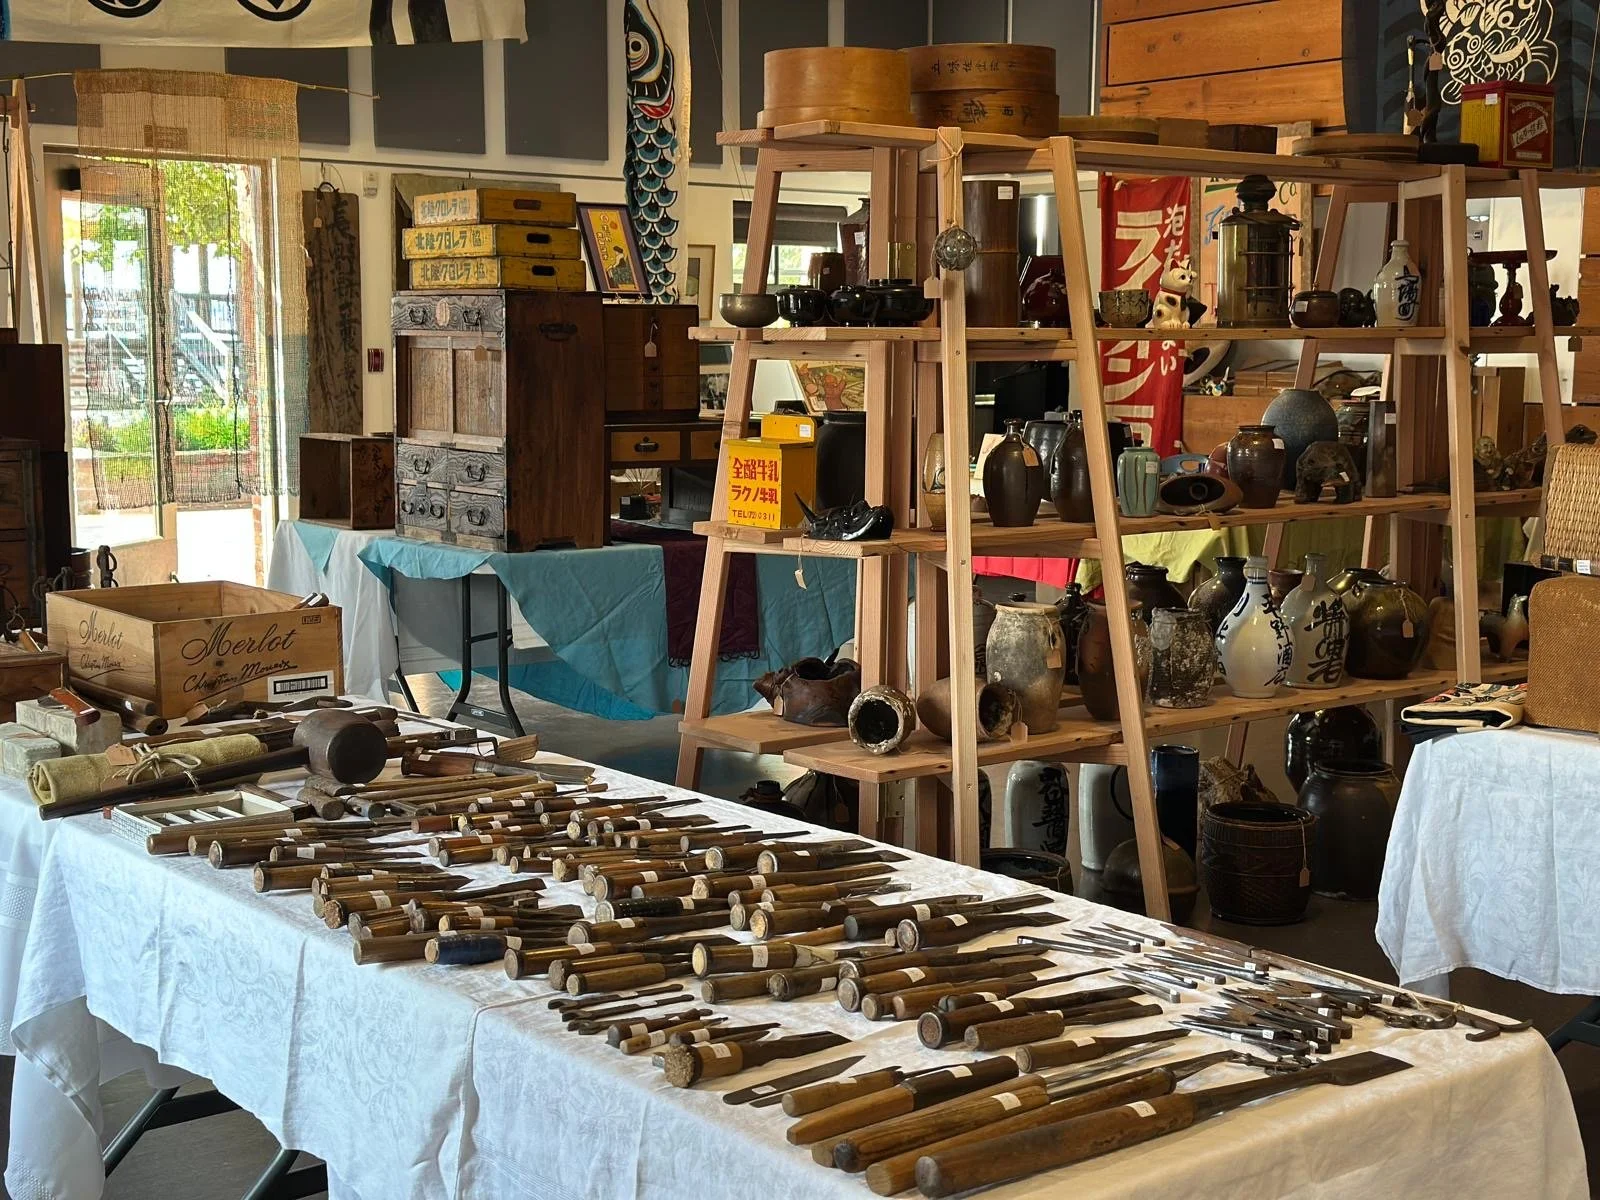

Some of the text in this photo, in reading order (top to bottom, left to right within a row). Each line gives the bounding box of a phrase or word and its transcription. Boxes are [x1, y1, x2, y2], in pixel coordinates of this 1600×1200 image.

[732, 457, 779, 482] 全酪牛乳
[731, 484, 779, 505] ラクノ牛乳
[79, 610, 124, 650] Merlot
[181, 620, 297, 666] Merlot
